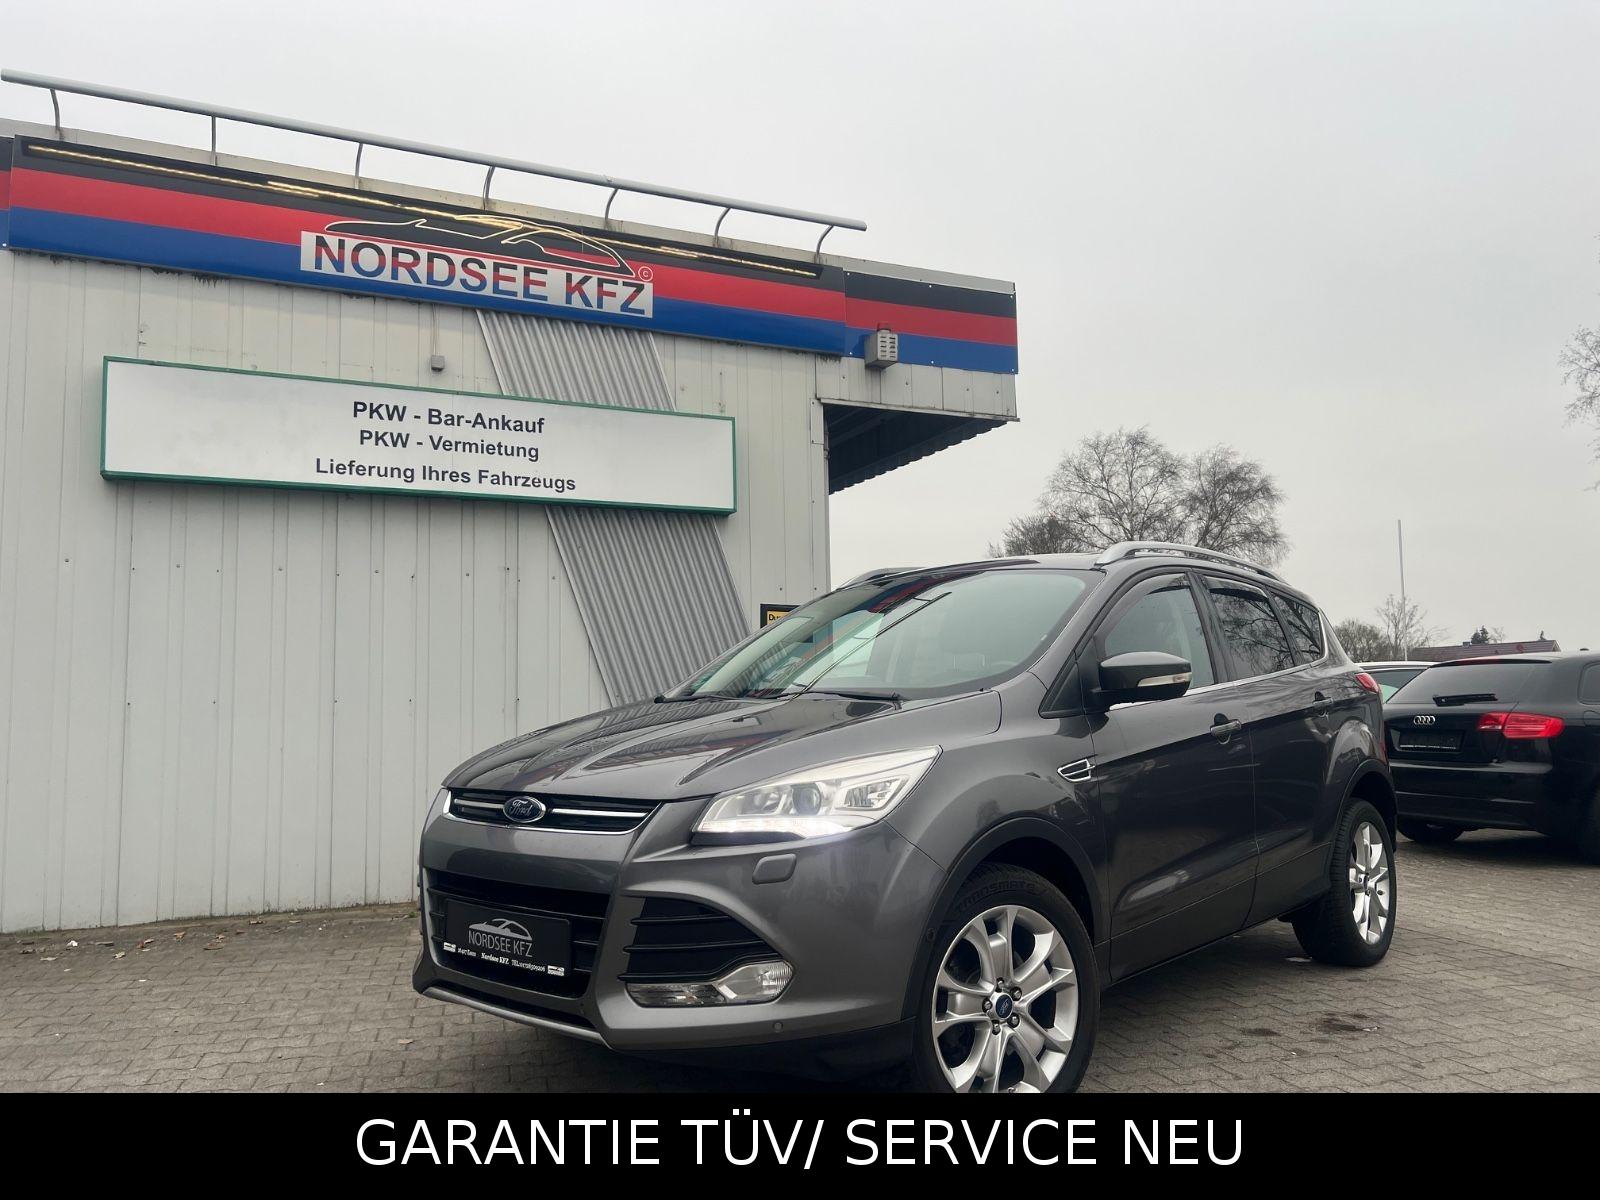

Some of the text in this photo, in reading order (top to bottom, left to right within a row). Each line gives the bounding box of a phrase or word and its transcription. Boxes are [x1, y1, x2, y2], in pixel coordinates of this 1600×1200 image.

[314, 234, 646, 315] NORDSEE KFZ
[353, 401, 407, 422] PKW
[428, 408, 545, 433] Bar-Ankauf
[360, 429, 410, 448] PKW
[429, 435, 539, 462] Vermietung
[315, 458, 576, 493] Lieferung Ihres Fahrzeugs
[468, 930, 511, 953] NORDSEE
[513, 940, 533, 957] KFZ
